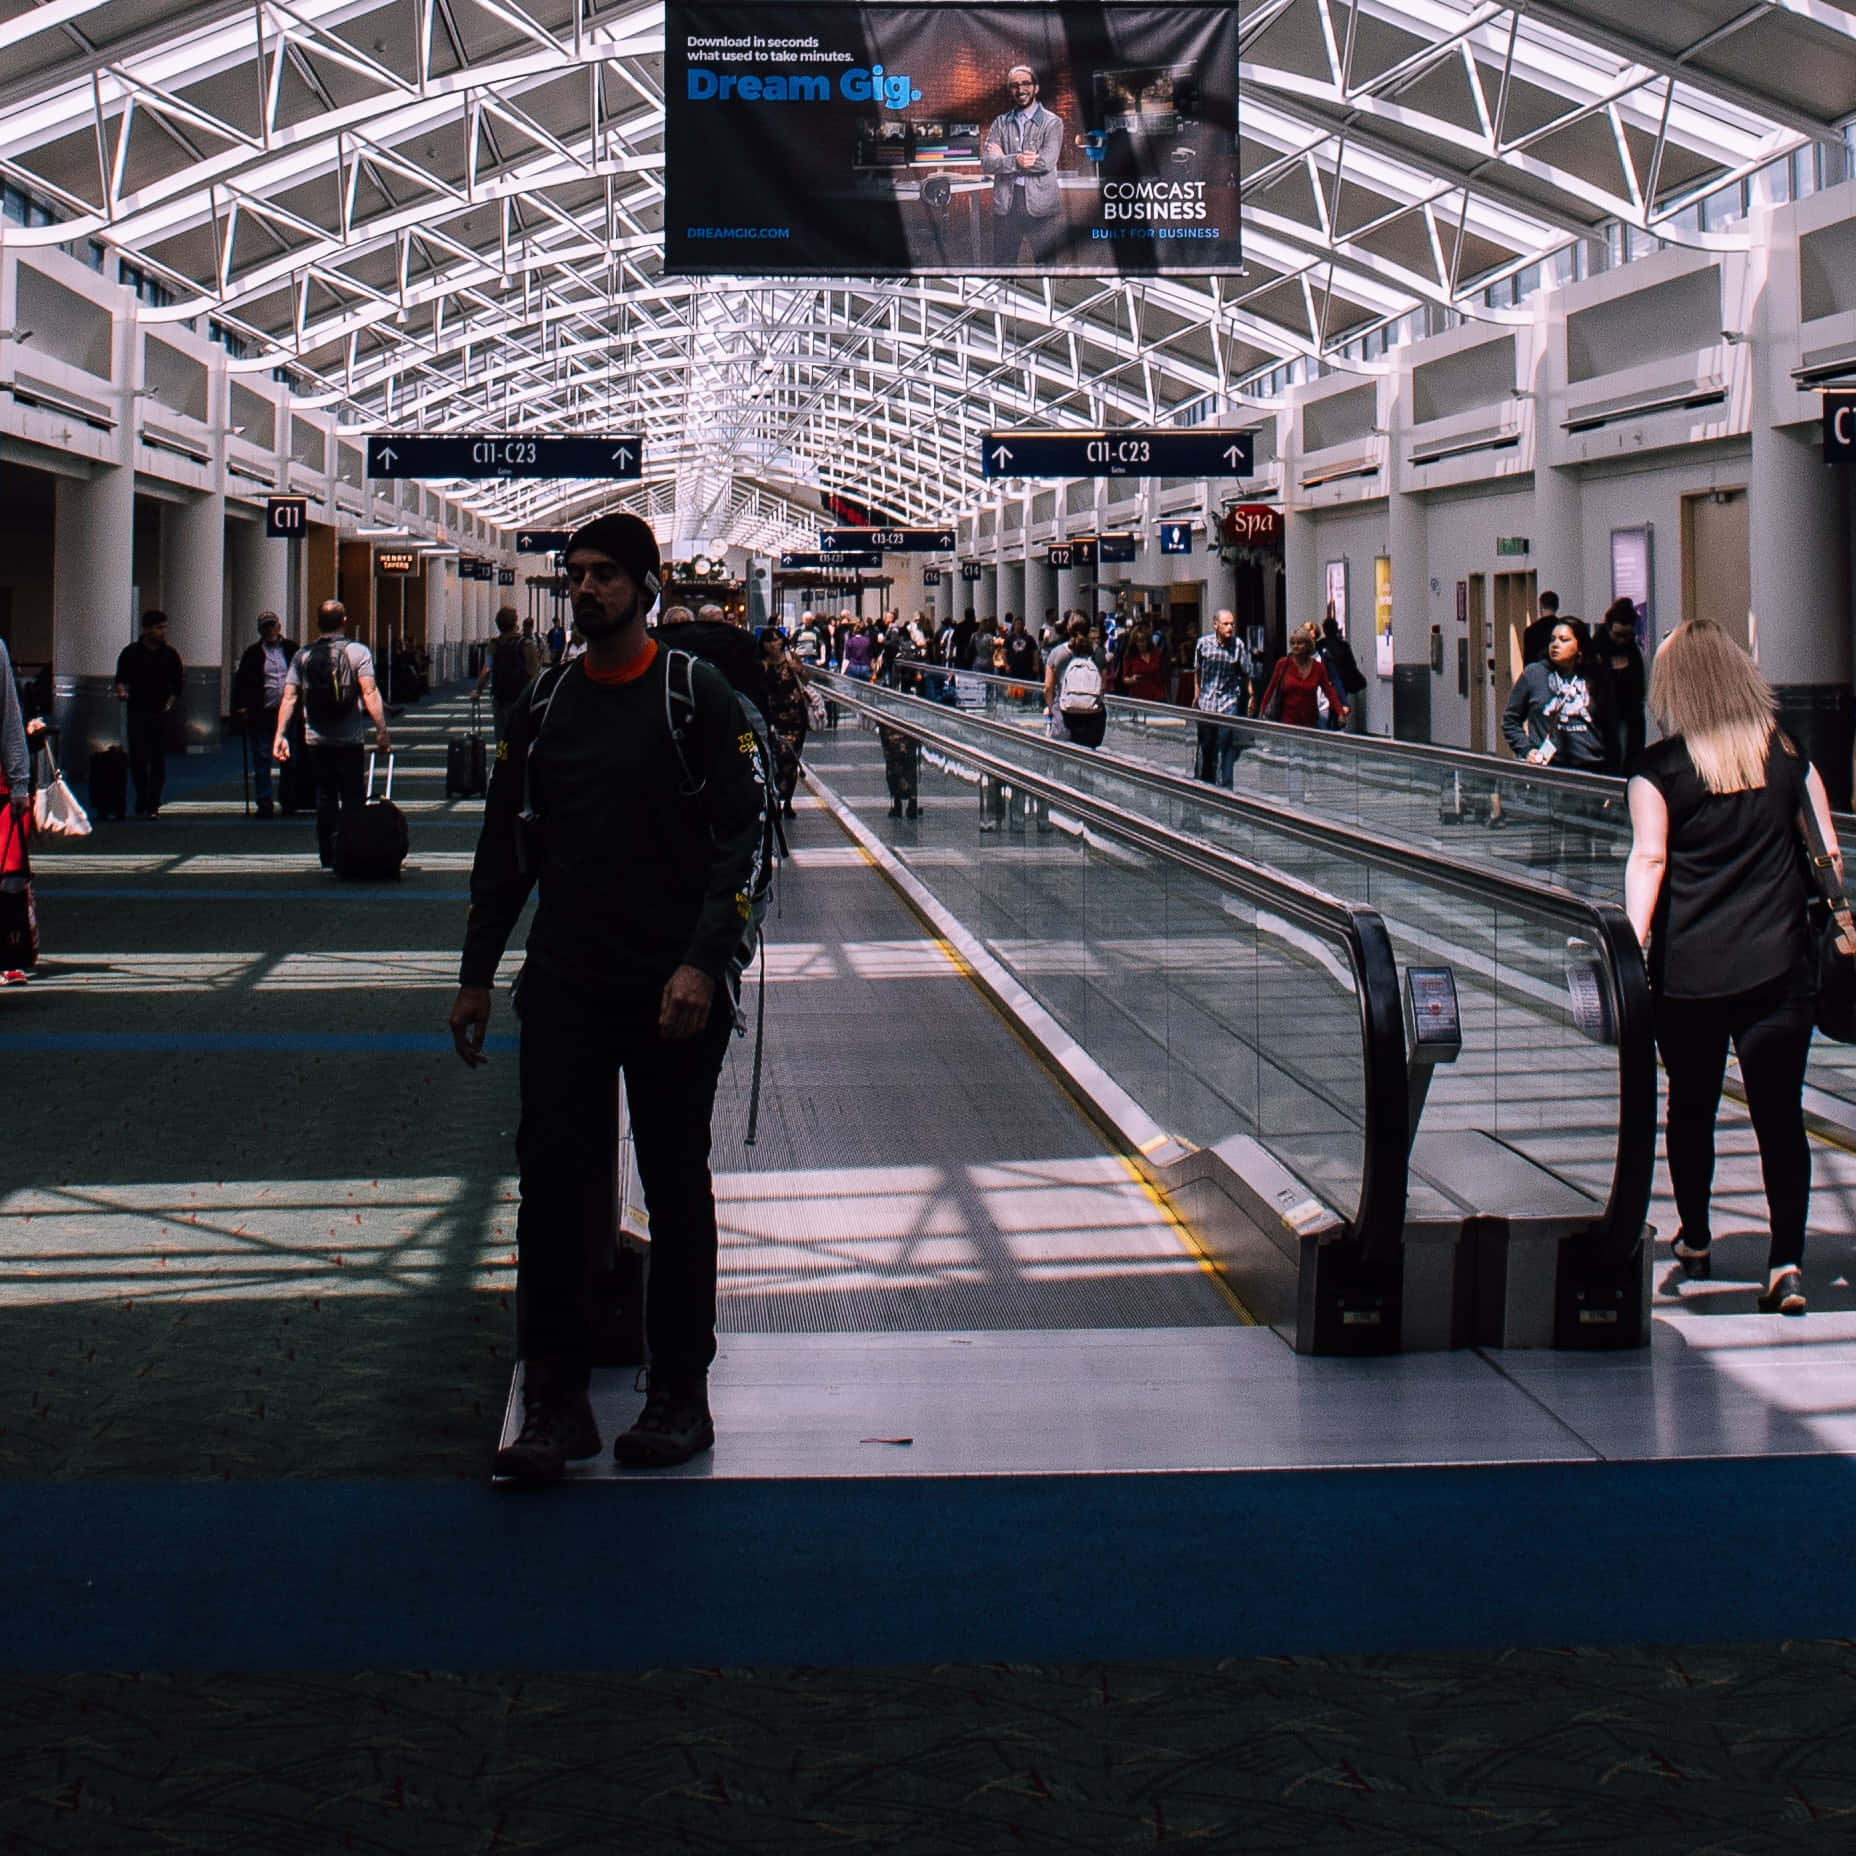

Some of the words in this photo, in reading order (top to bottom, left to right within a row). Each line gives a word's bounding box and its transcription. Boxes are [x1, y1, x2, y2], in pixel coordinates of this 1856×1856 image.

[687, 36, 751, 48] Download
[753, 36, 765, 48] in
[767, 36, 819, 48] seconds
[687, 50, 720, 62] what
[722, 51, 753, 62] used
[755, 51, 769, 62] to
[770, 51, 798, 62] take
[799, 51, 854, 63] minutes.
[687, 68, 831, 101] Dream
[839, 64, 922, 110] Gig.
[1103, 182, 1207, 200] COMCAST
[1104, 201, 1207, 220] BUSINESS
[687, 227, 791, 239] DREAMGIG.COM
[1091, 228, 1125, 239] BUILT
[1129, 228, 1155, 239] FOR
[1158, 227, 1220, 239] BUSINESS
[473, 442, 536, 463] C11-C23
[1087, 441, 1150, 462] C11-C23
[274, 506, 299, 528] C11
[1235, 511, 1273, 541] Spa
[1051, 550, 1069, 564] C12
